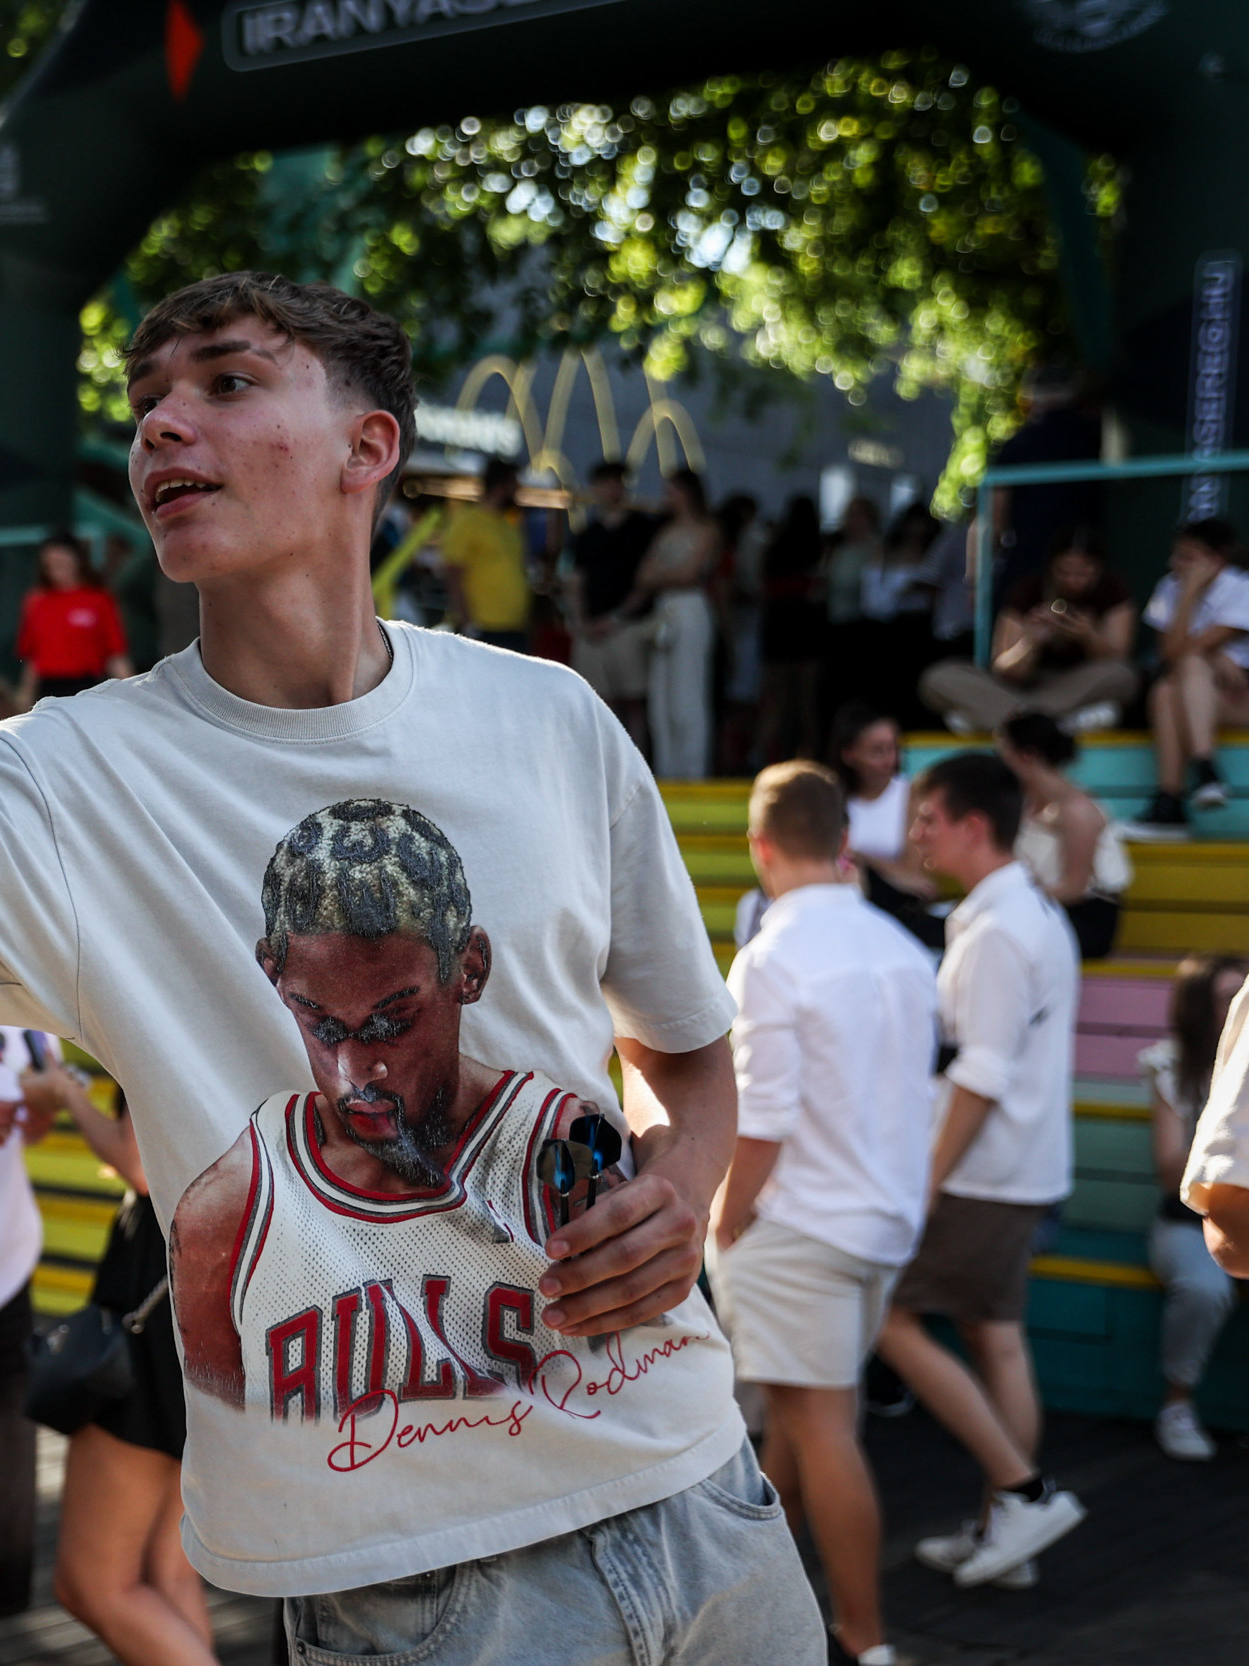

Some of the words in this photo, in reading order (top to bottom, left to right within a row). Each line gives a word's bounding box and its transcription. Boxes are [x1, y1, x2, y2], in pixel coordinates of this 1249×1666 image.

[242, 0, 540, 56] IRANYA
[327, 1389, 533, 1472] Dennis
[528, 1330, 710, 1419] Rodman
